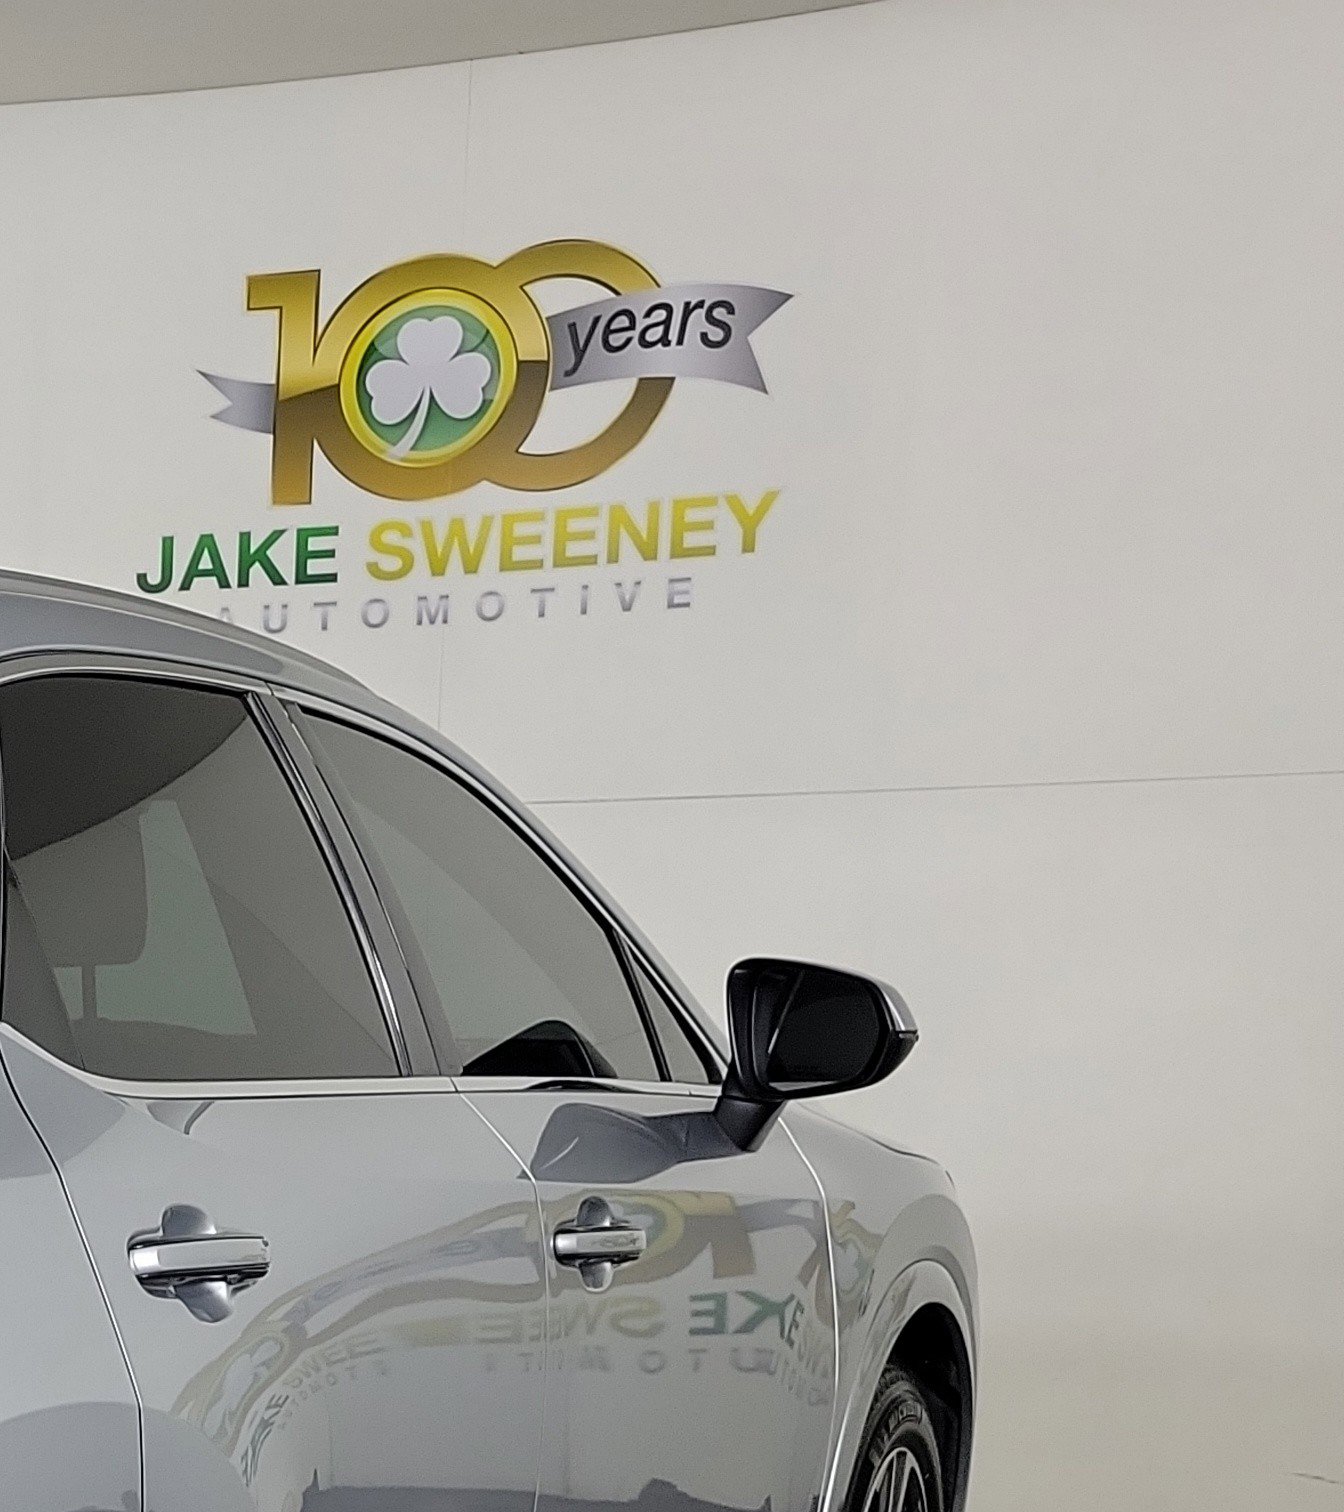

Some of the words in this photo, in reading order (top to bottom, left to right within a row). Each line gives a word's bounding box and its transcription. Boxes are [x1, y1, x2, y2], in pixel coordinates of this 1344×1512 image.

[563, 299, 737, 378] years
[135, 524, 341, 594] JAKE
[363, 488, 783, 586] SWEENEY
